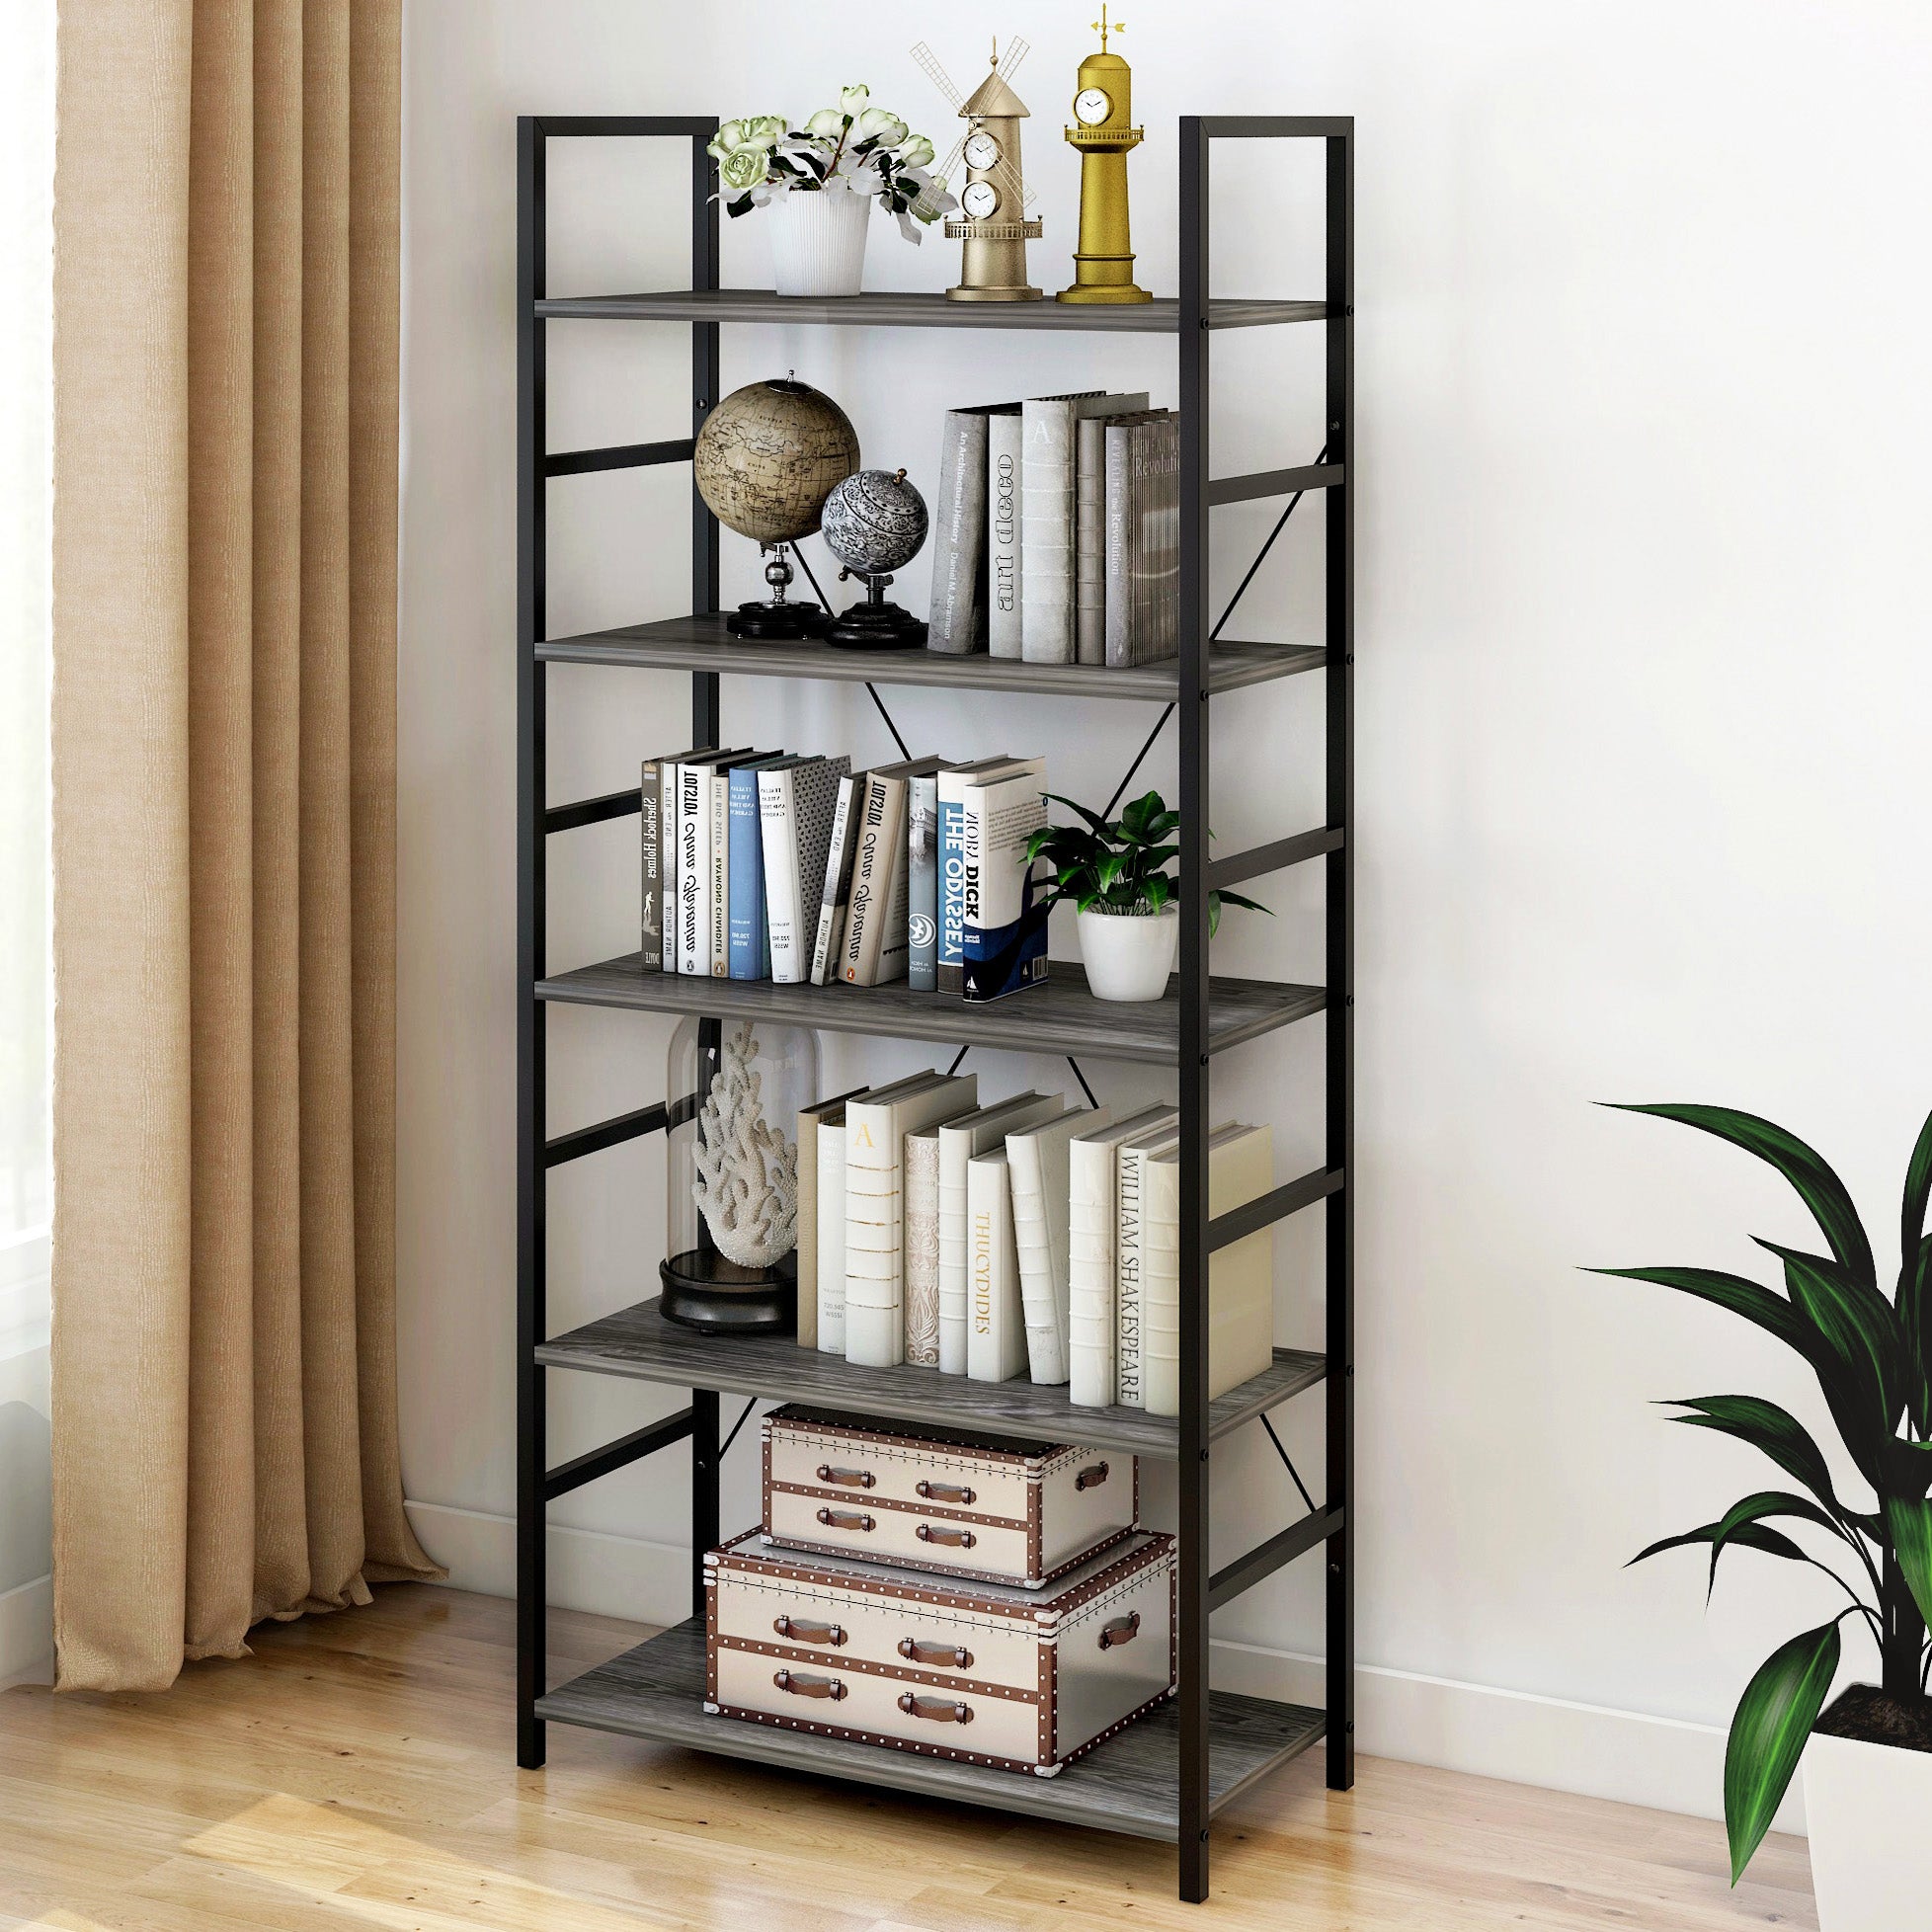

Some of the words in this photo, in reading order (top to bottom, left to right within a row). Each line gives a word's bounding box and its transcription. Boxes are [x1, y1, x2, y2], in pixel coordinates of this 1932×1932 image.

[959, 432, 968, 446] An
[1034, 421, 1053, 443] A
[996, 454, 1014, 544] deco
[950, 507, 963, 544] History
[1111, 513, 1123, 576] Revolution
[949, 552, 959, 580] Daniel
[996, 555, 1014, 611] art
[943, 593, 956, 640] Abramson
[854, 1122, 876, 1148] A
[1121, 1155, 1139, 1249] WILLIAM
[976, 1211, 991, 1334] THUCYDIDES
[1121, 1254, 1139, 1401] SHAKESPEARE
